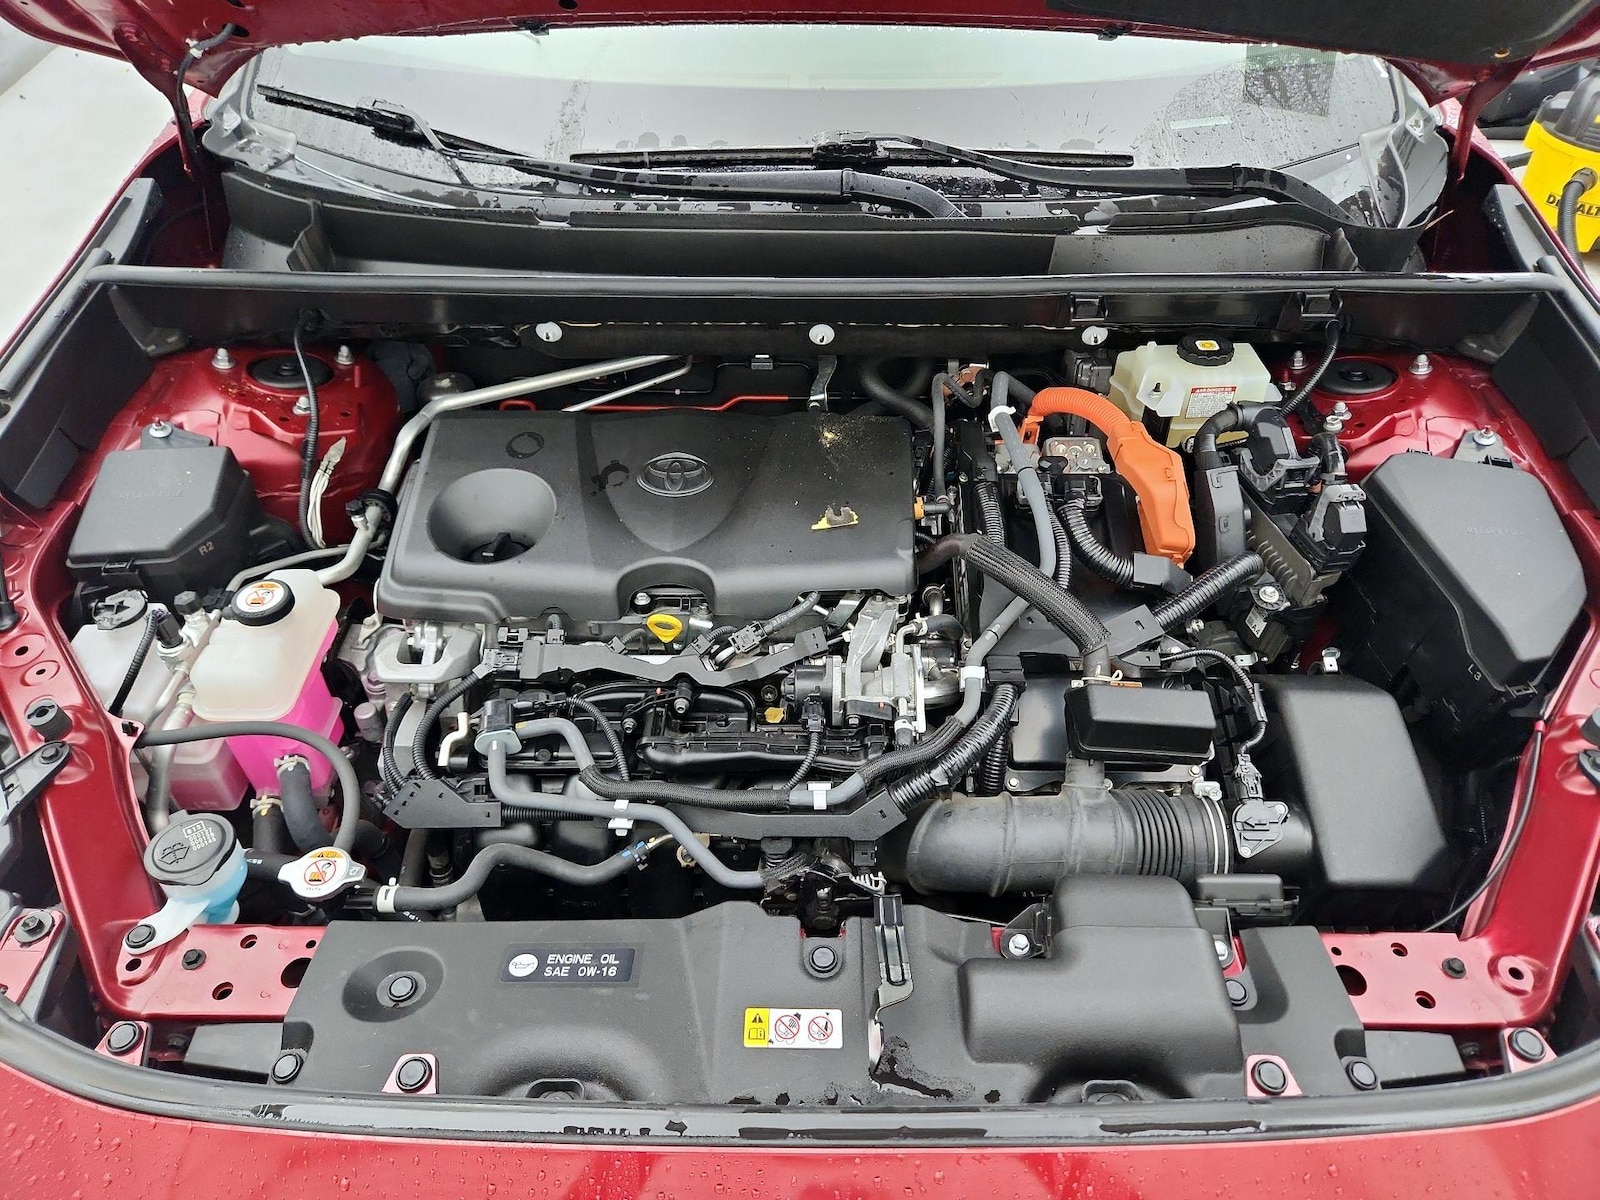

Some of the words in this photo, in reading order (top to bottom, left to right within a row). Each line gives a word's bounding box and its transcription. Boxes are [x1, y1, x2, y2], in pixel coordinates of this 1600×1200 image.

[199, 541, 215, 556] R2
[1467, 663, 1482, 681] L3
[546, 953, 594, 965] ENGINE
[600, 953, 620, 965] OIL
[543, 966, 571, 977] SAE
